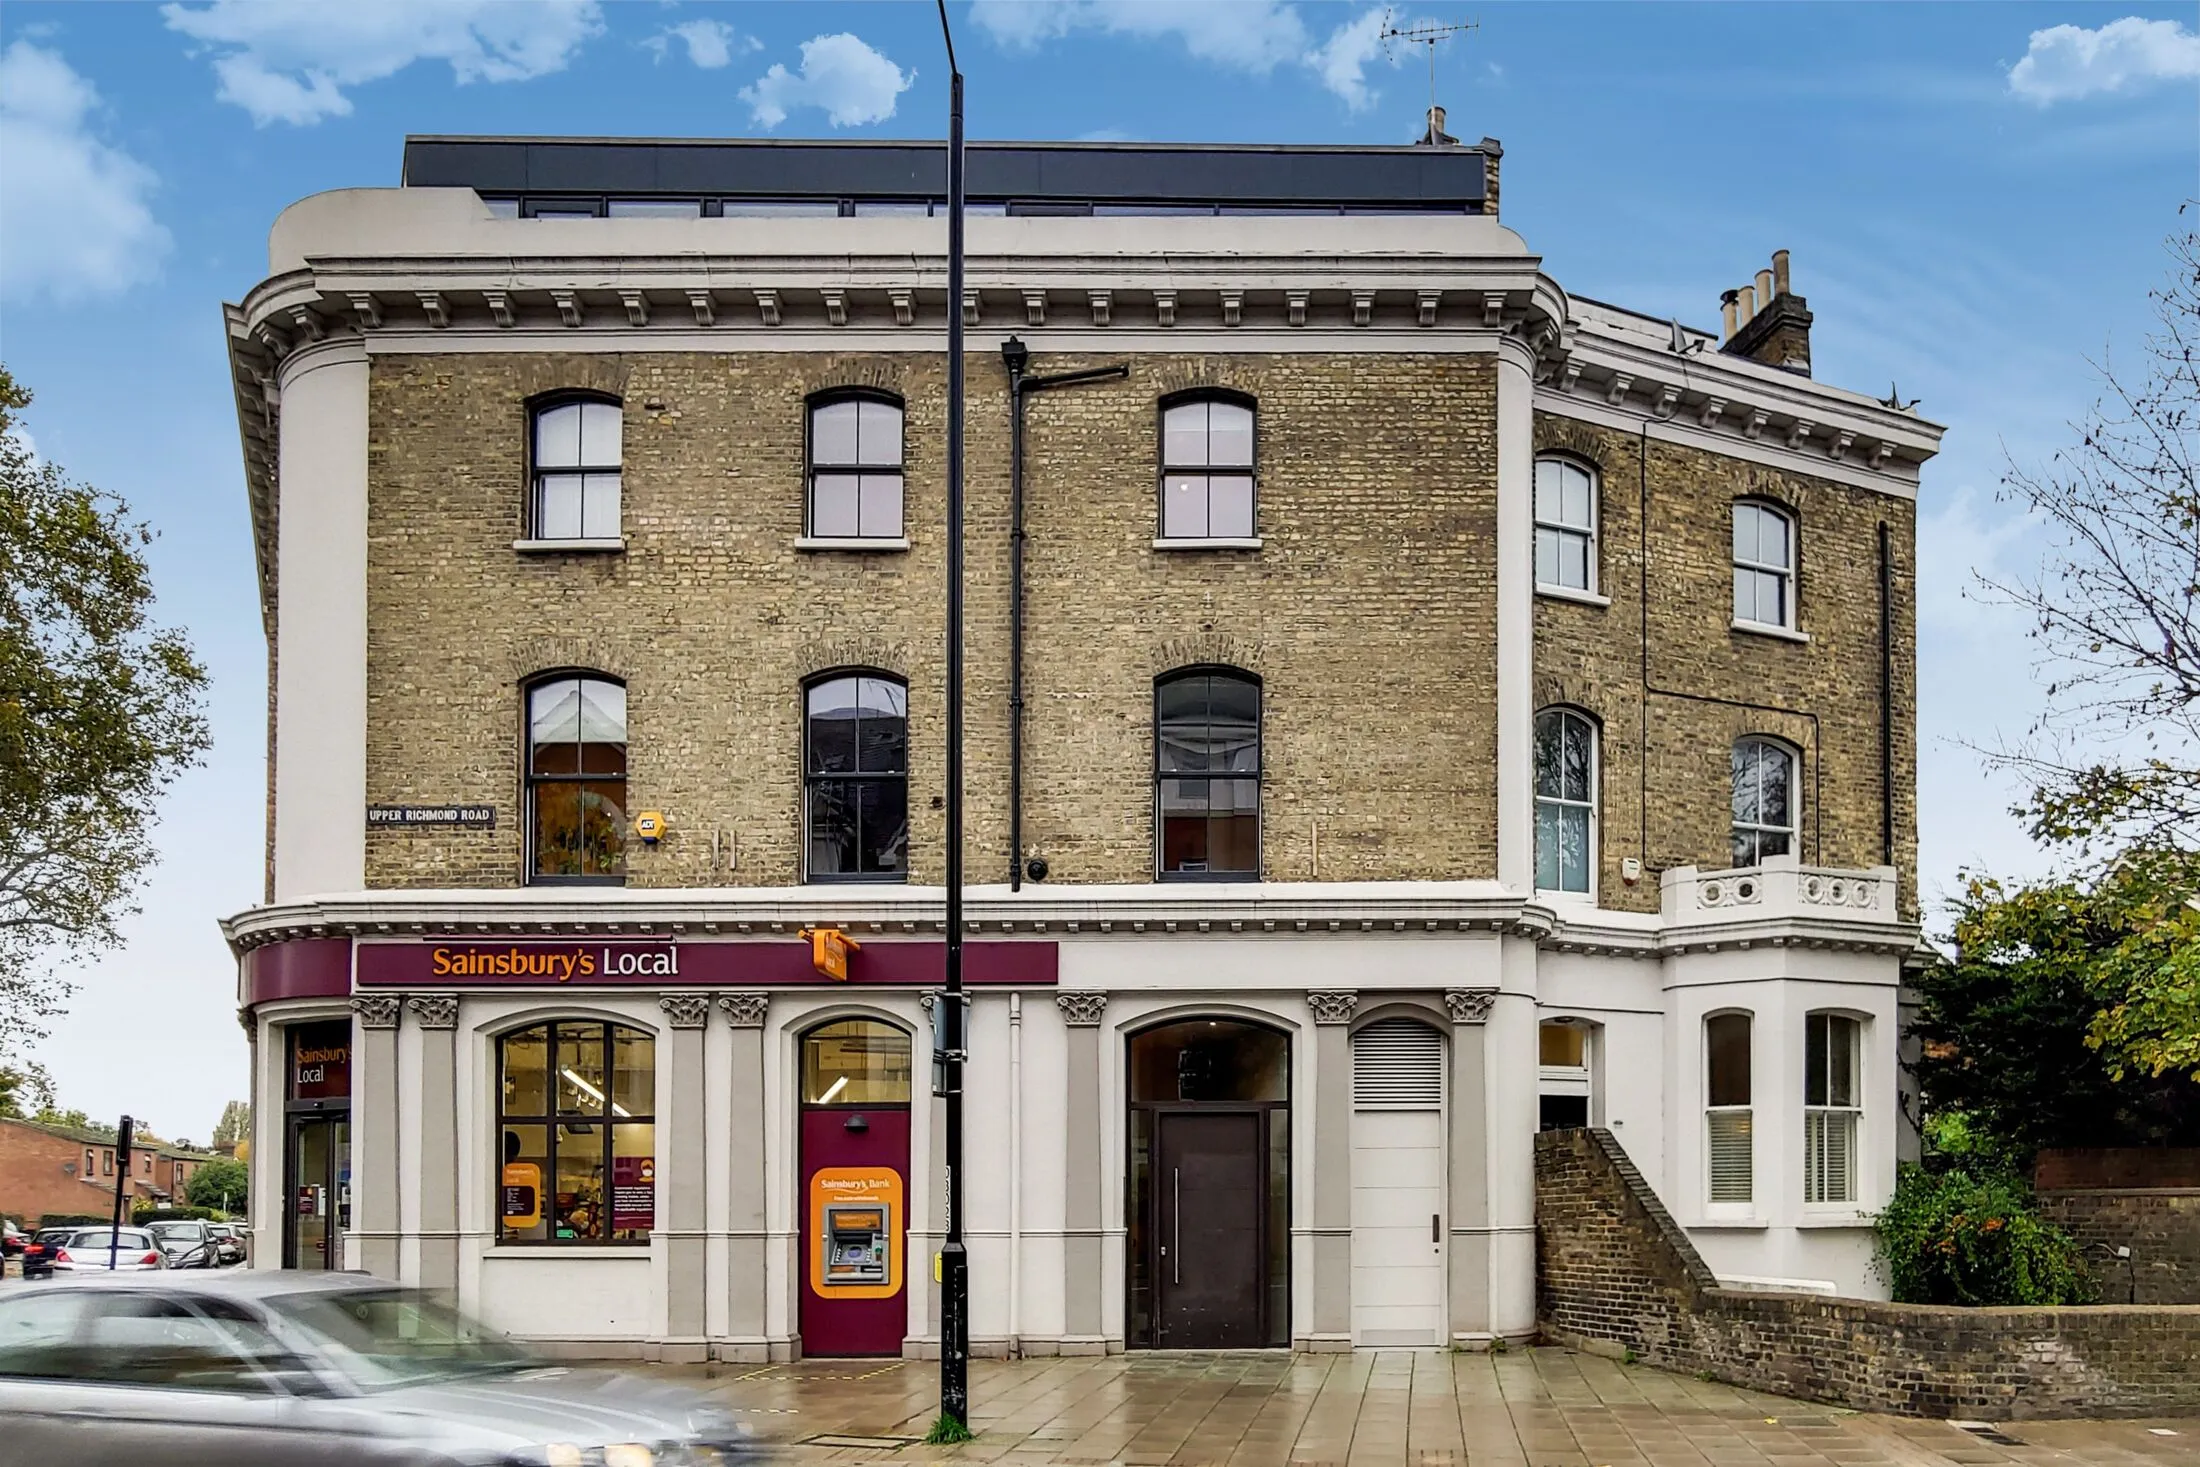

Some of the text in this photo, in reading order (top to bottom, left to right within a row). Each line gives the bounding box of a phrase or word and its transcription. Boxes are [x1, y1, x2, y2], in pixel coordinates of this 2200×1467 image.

[369, 809, 490, 821] UPPER RICHMOND ROAD
[432, 946, 679, 981] Sainsbury's Local
[297, 1064, 325, 1083] Local
[820, 1178, 891, 1190] Sainsbury's Bank
